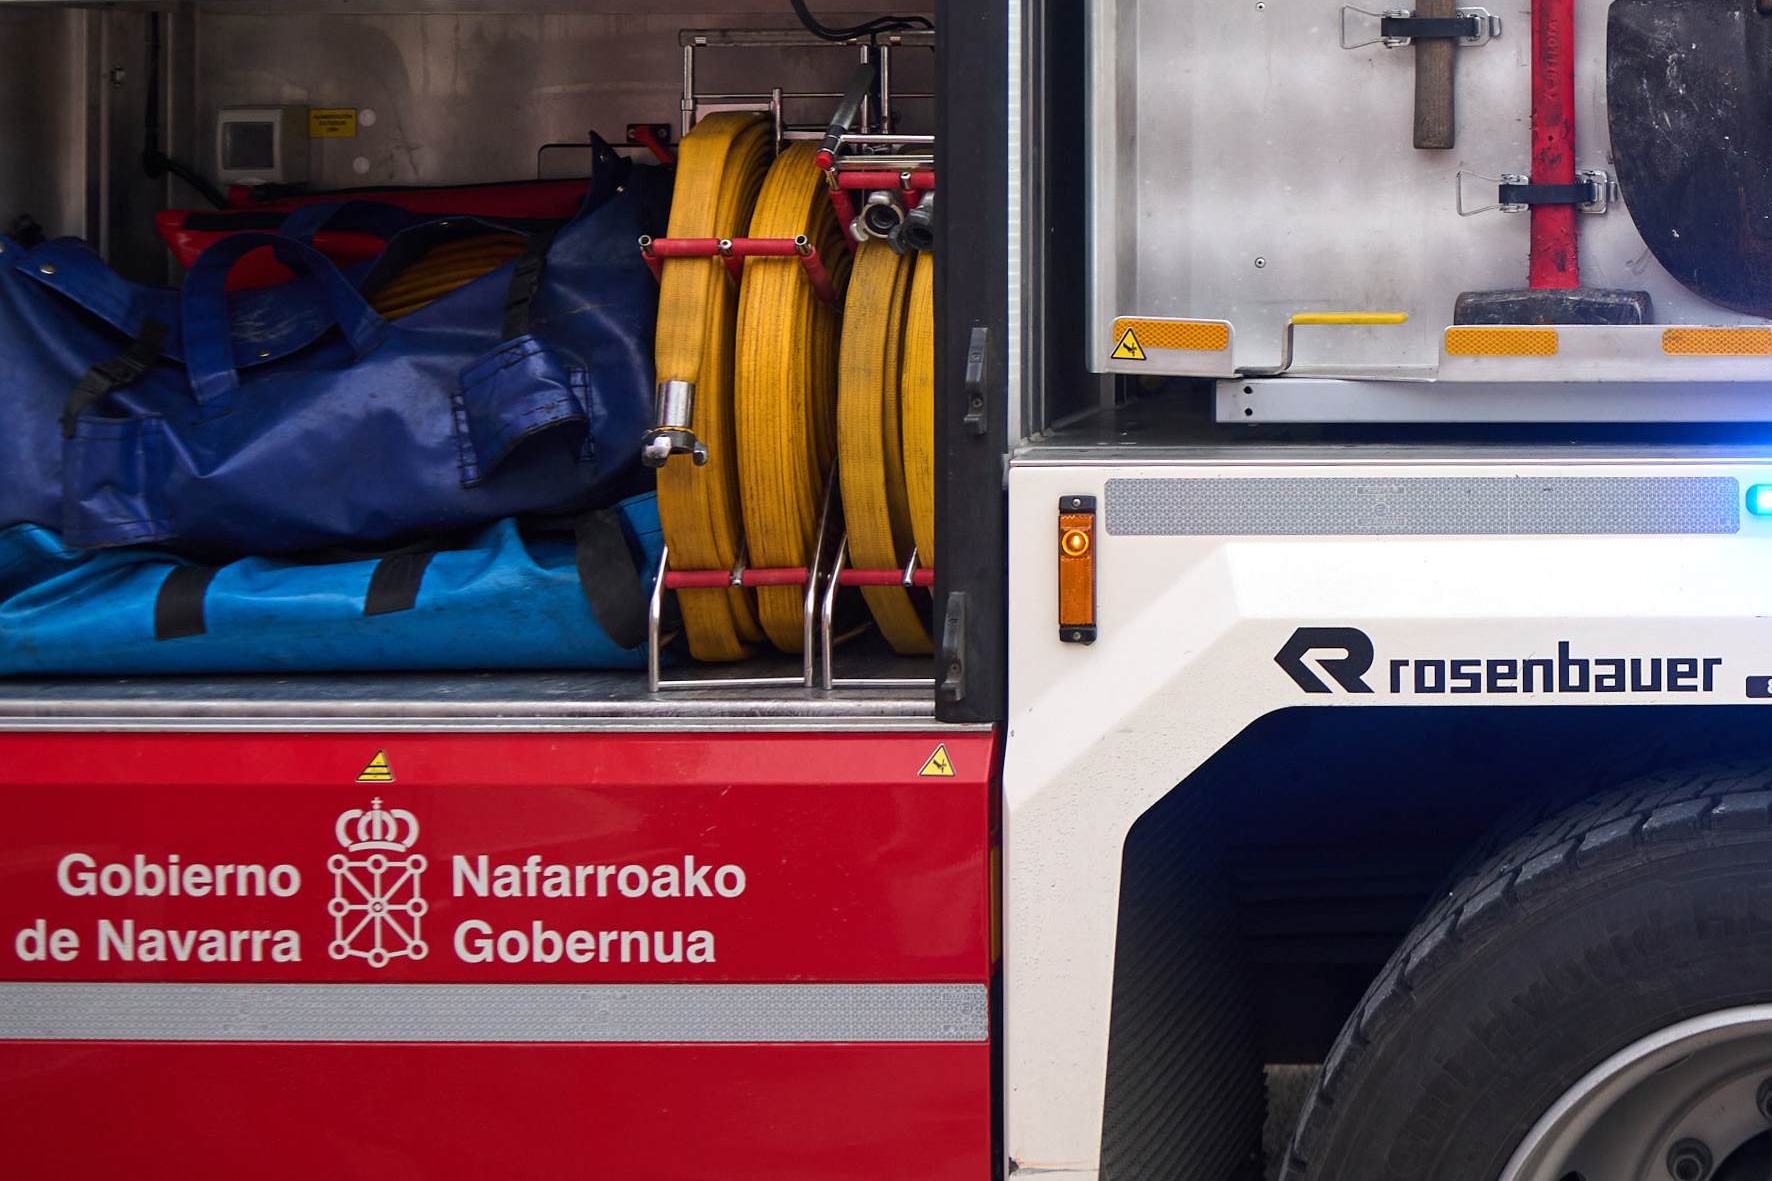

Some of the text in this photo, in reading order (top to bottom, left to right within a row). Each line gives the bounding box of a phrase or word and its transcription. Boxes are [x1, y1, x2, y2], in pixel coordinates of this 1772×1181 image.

[1389, 641, 1723, 694] rosenbauer
[57, 853, 302, 897] Gobierno
[452, 855, 747, 898] Nafarroako
[15, 918, 303, 962] de Navarra
[453, 919, 717, 963] Gobernua
